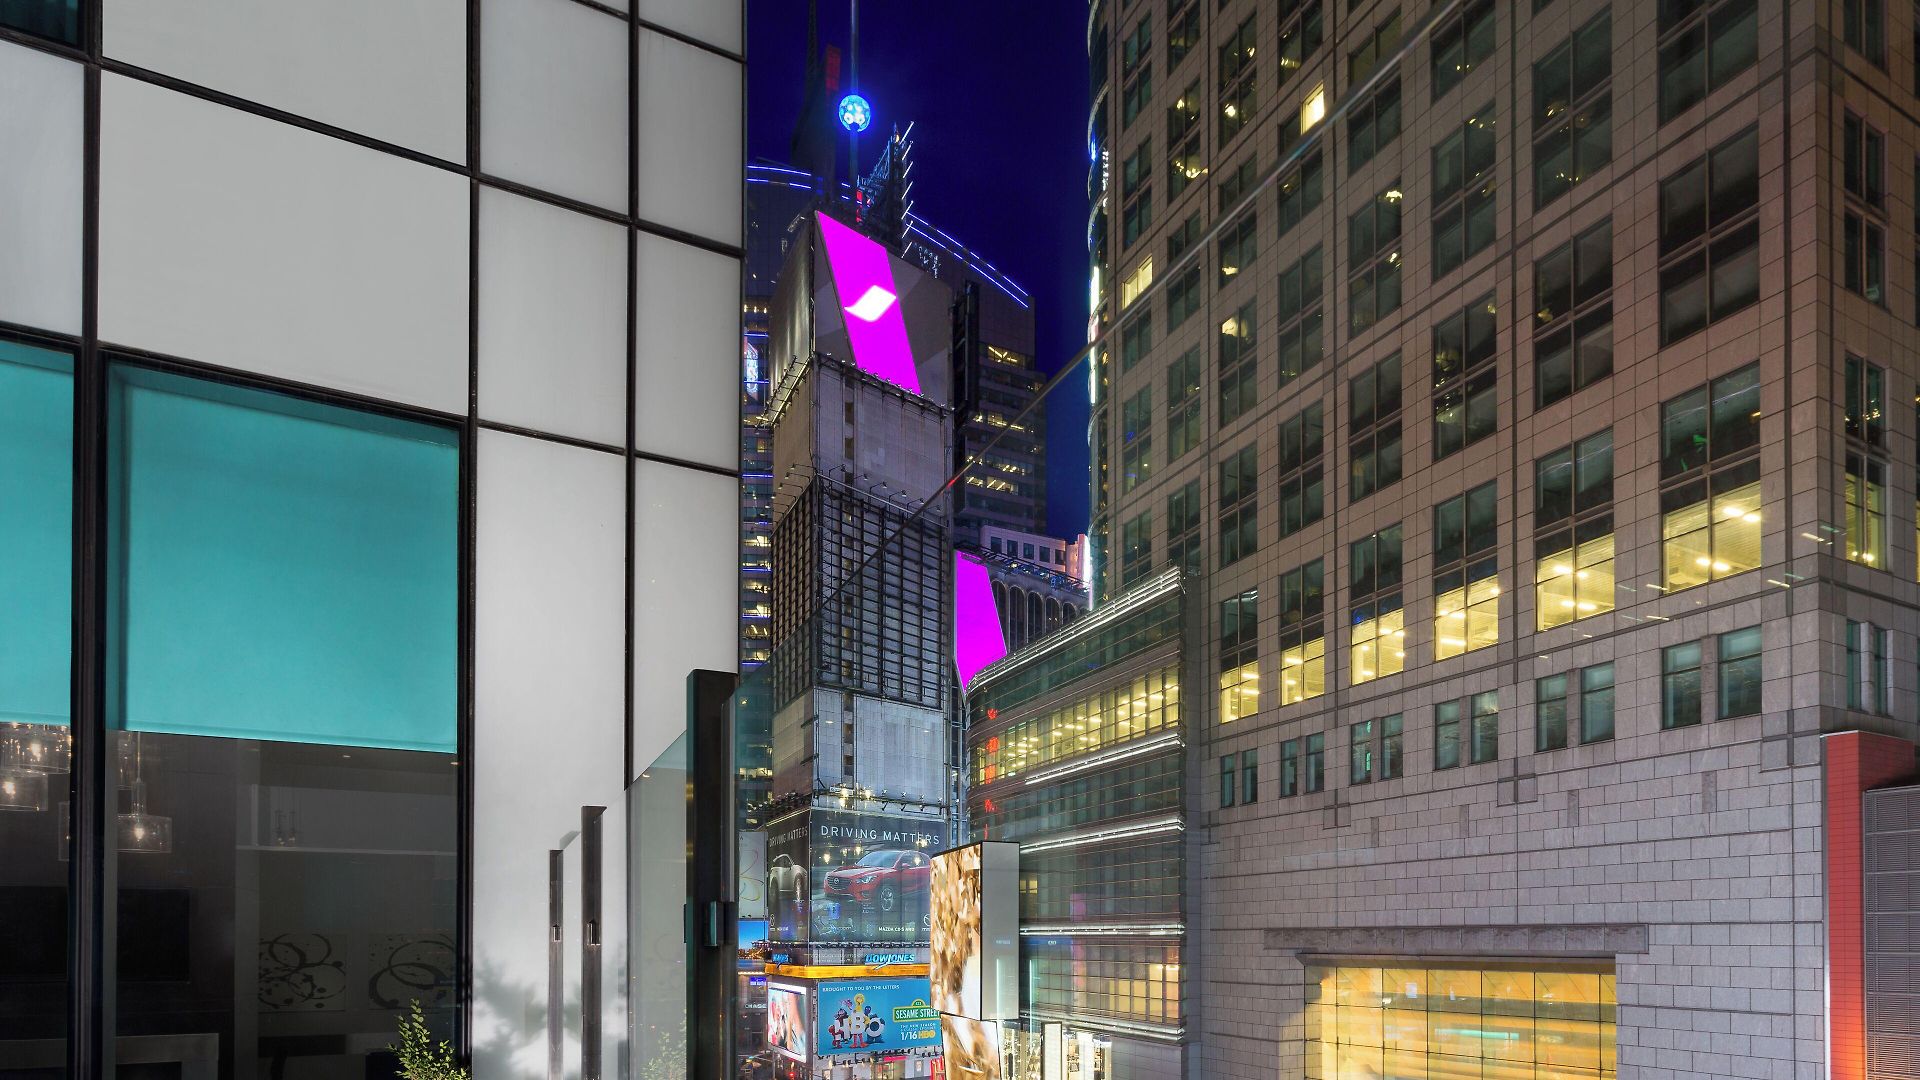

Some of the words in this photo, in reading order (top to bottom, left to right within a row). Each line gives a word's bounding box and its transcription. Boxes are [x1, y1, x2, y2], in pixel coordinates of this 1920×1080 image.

[821, 825, 877, 840] DRIVING
[883, 830, 940, 845] MATTERS
[895, 1009, 919, 1019] SESAME
[900, 1030, 918, 1040] 1/16
